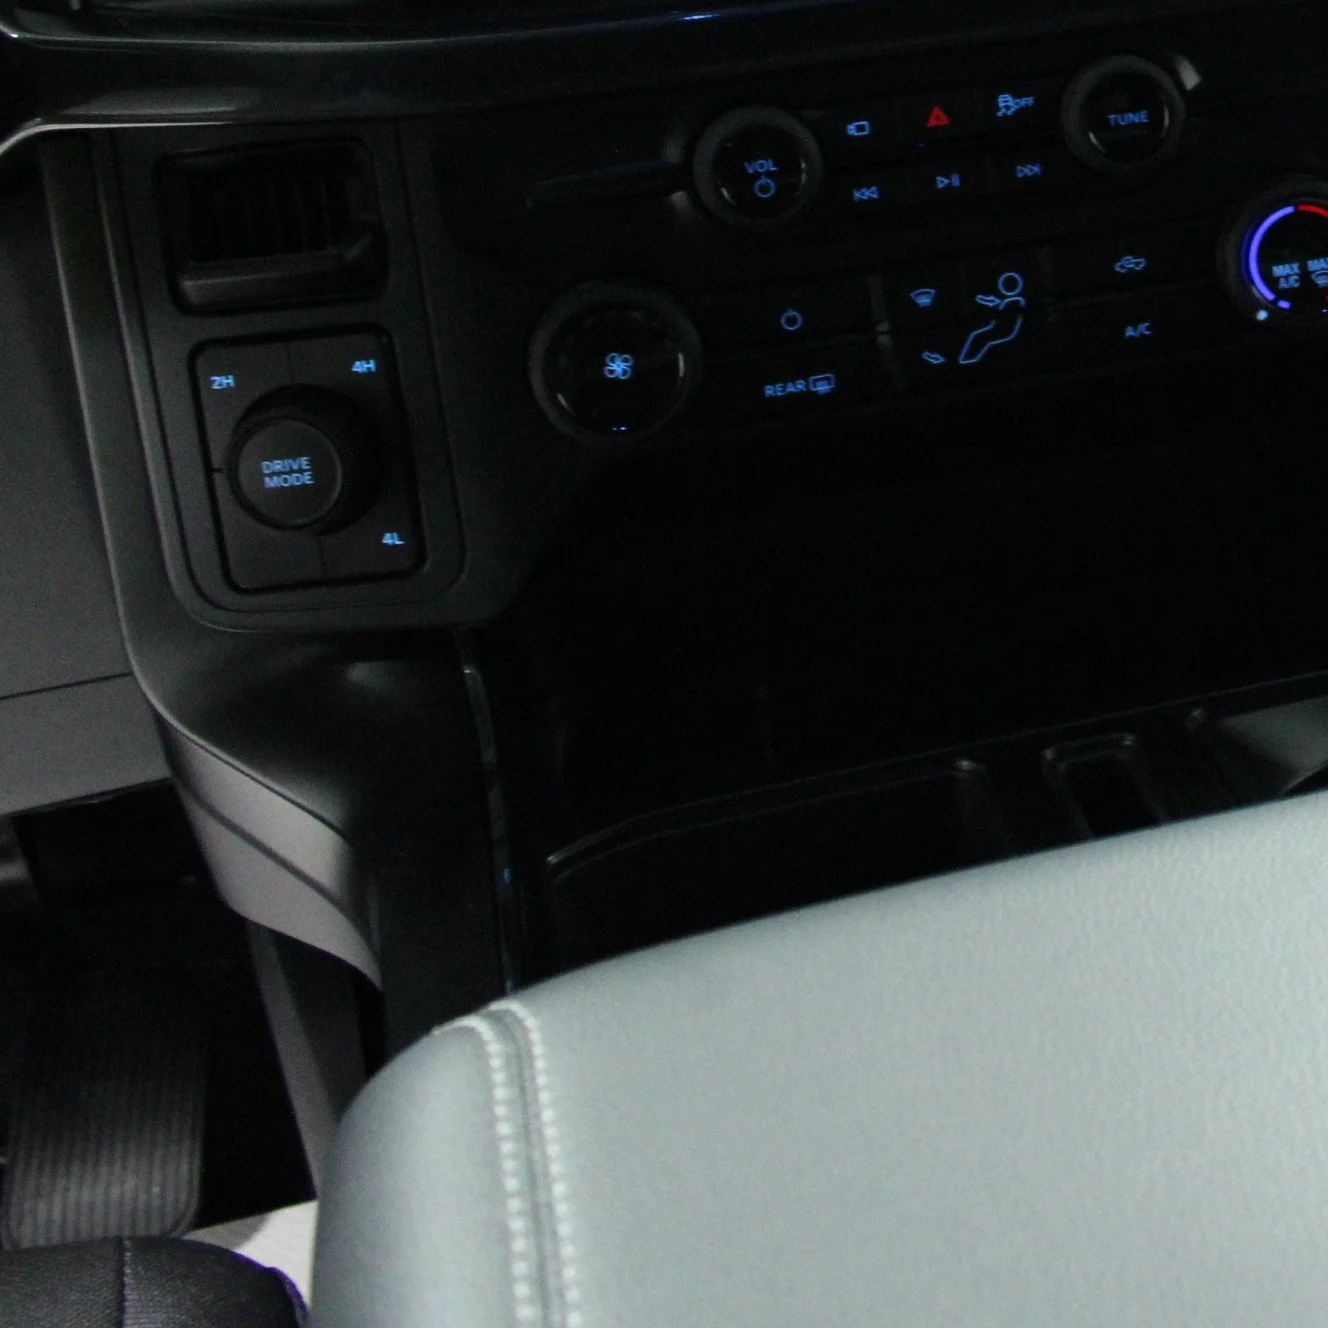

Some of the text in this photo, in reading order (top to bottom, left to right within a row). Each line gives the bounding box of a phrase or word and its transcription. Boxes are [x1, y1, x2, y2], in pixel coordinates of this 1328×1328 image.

[1108, 109, 1149, 127] TUNE
[744, 159, 778, 174] VOL
[1124, 322, 1151, 338] A/C
[351, 358, 376, 374] 4H
[211, 375, 235, 390] 2H
[764, 379, 806, 398] REAR
[261, 456, 312, 474] DRIVE
[264, 472, 315, 489] MODE
[382, 532, 404, 546] 4L
